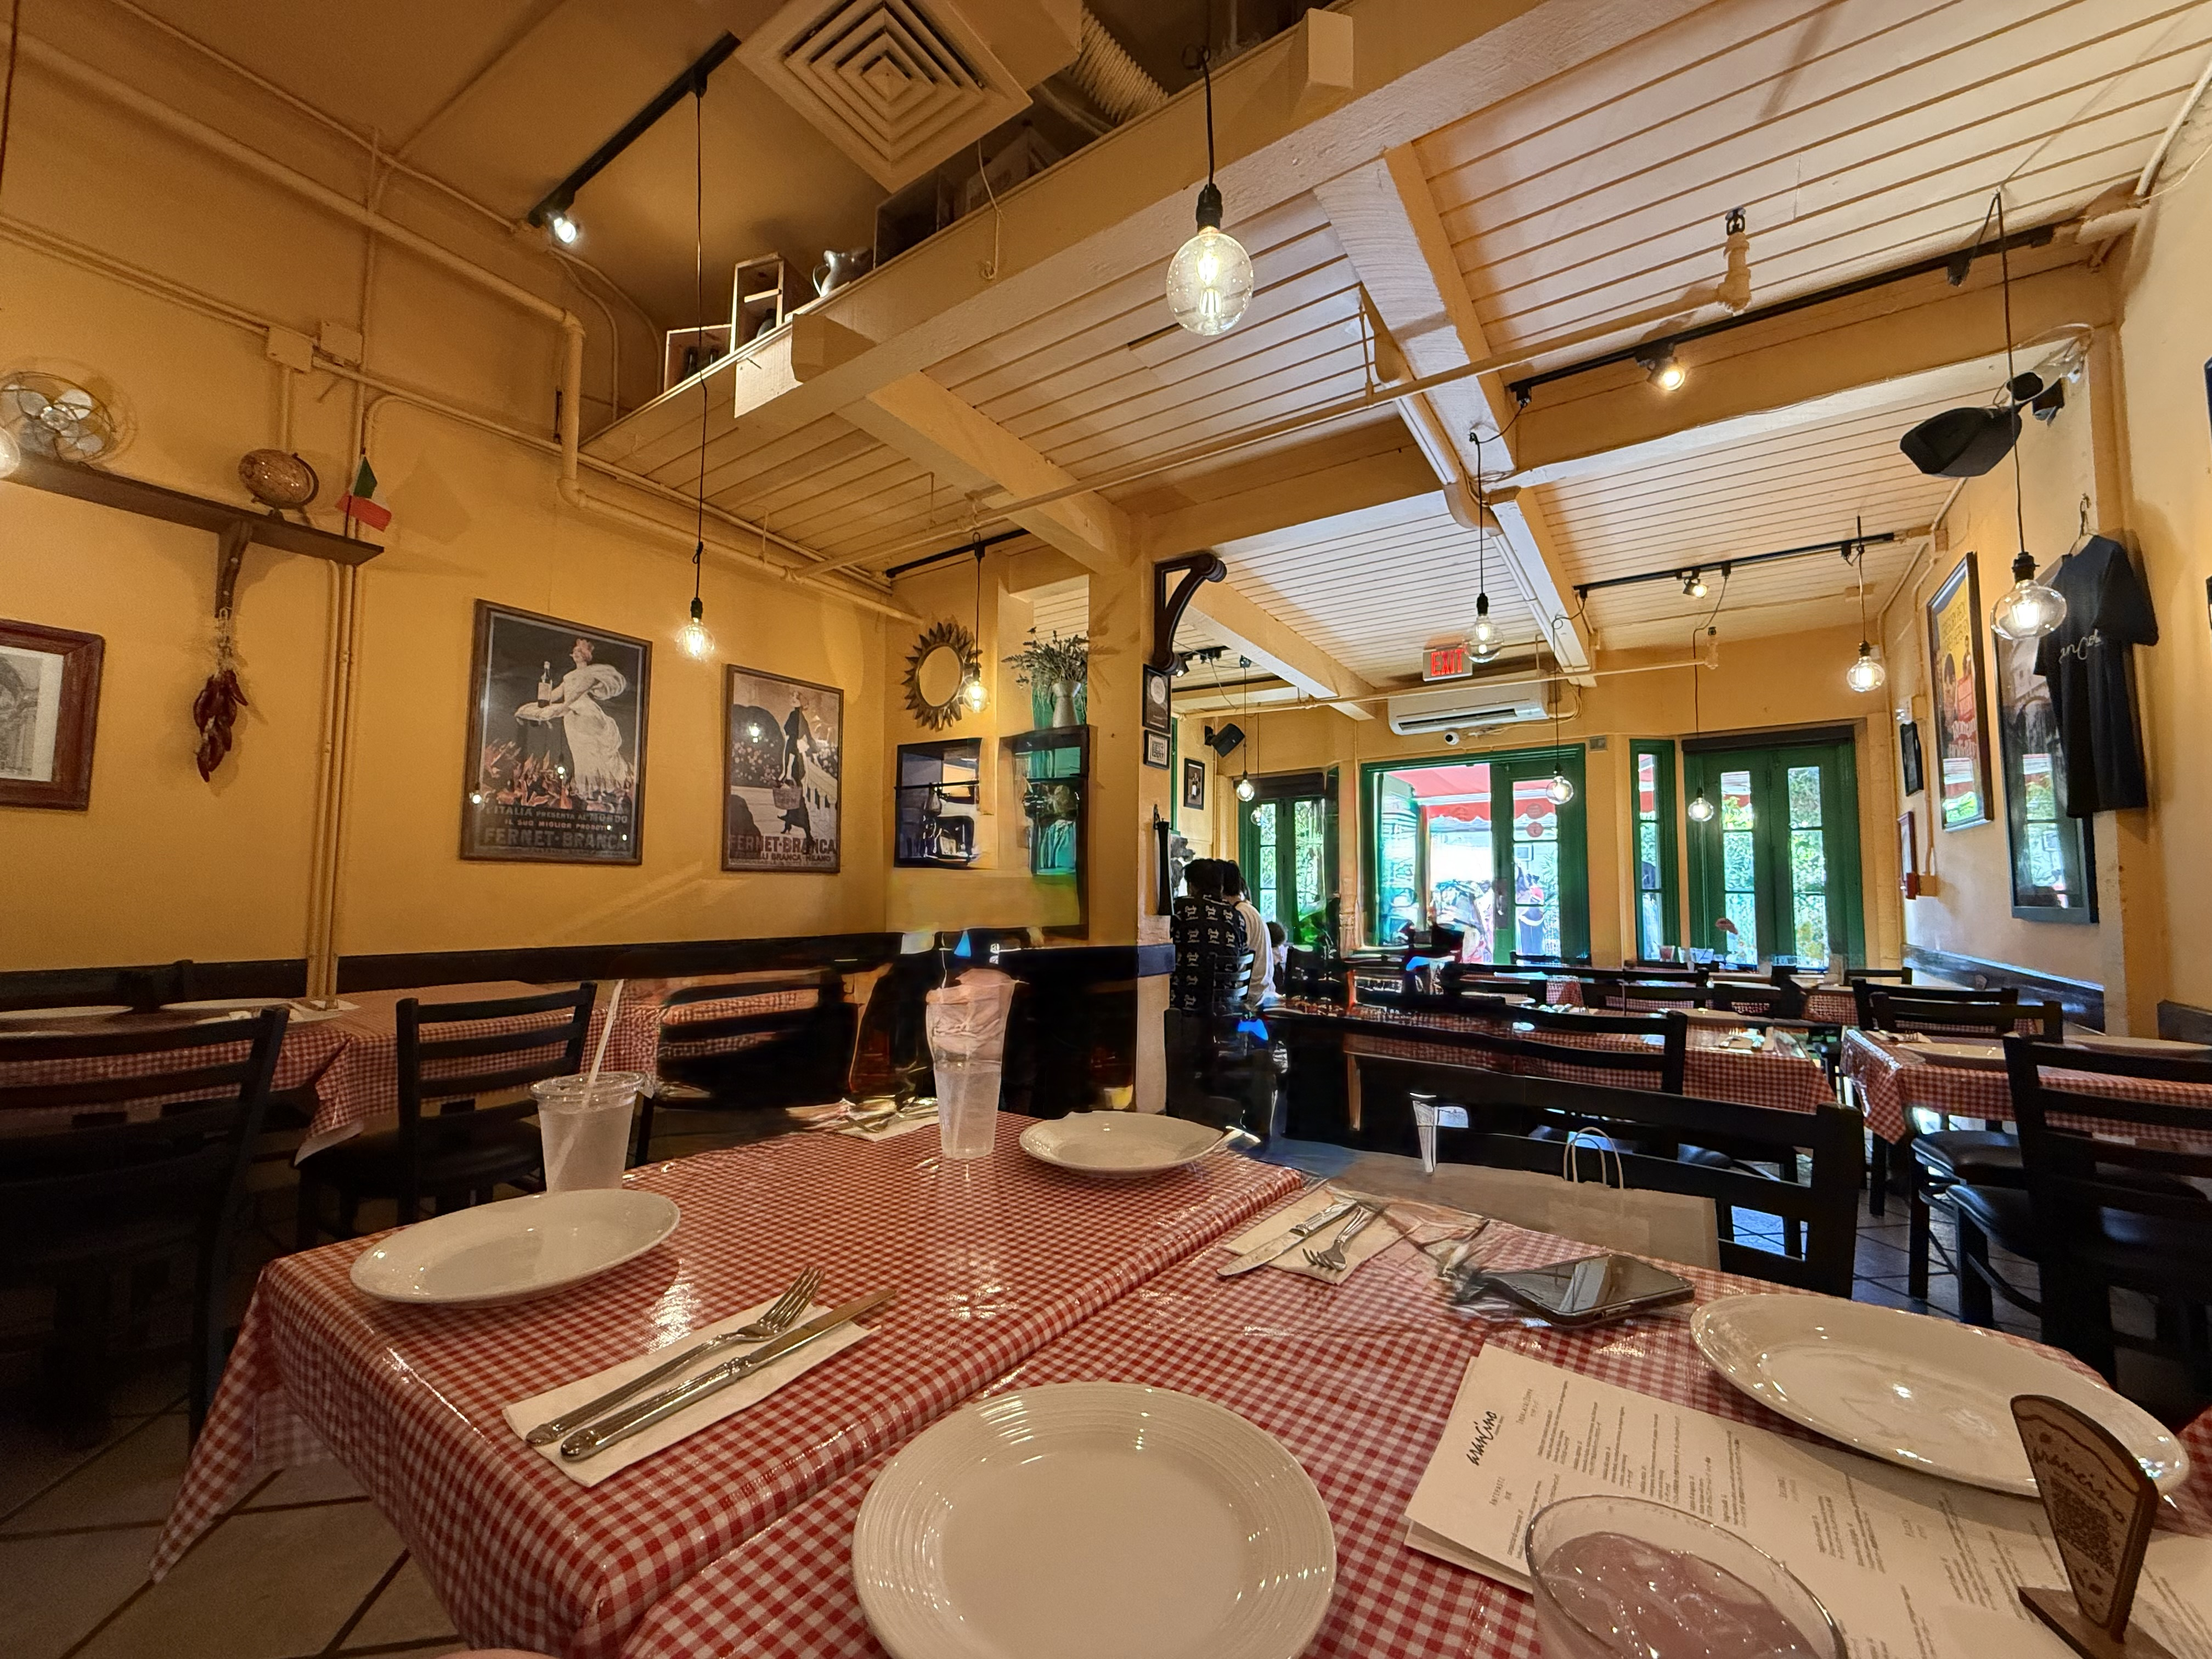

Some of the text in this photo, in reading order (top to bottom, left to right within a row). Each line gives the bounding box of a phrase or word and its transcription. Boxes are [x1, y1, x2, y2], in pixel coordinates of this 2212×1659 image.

[1431, 648, 1464, 676] EXIT
[536, 811, 575, 820] PRESENTA
[589, 812, 628, 823] MONDO
[538, 821, 572, 829] MIGLIOR
[771, 852, 802, 861] BRANCA
